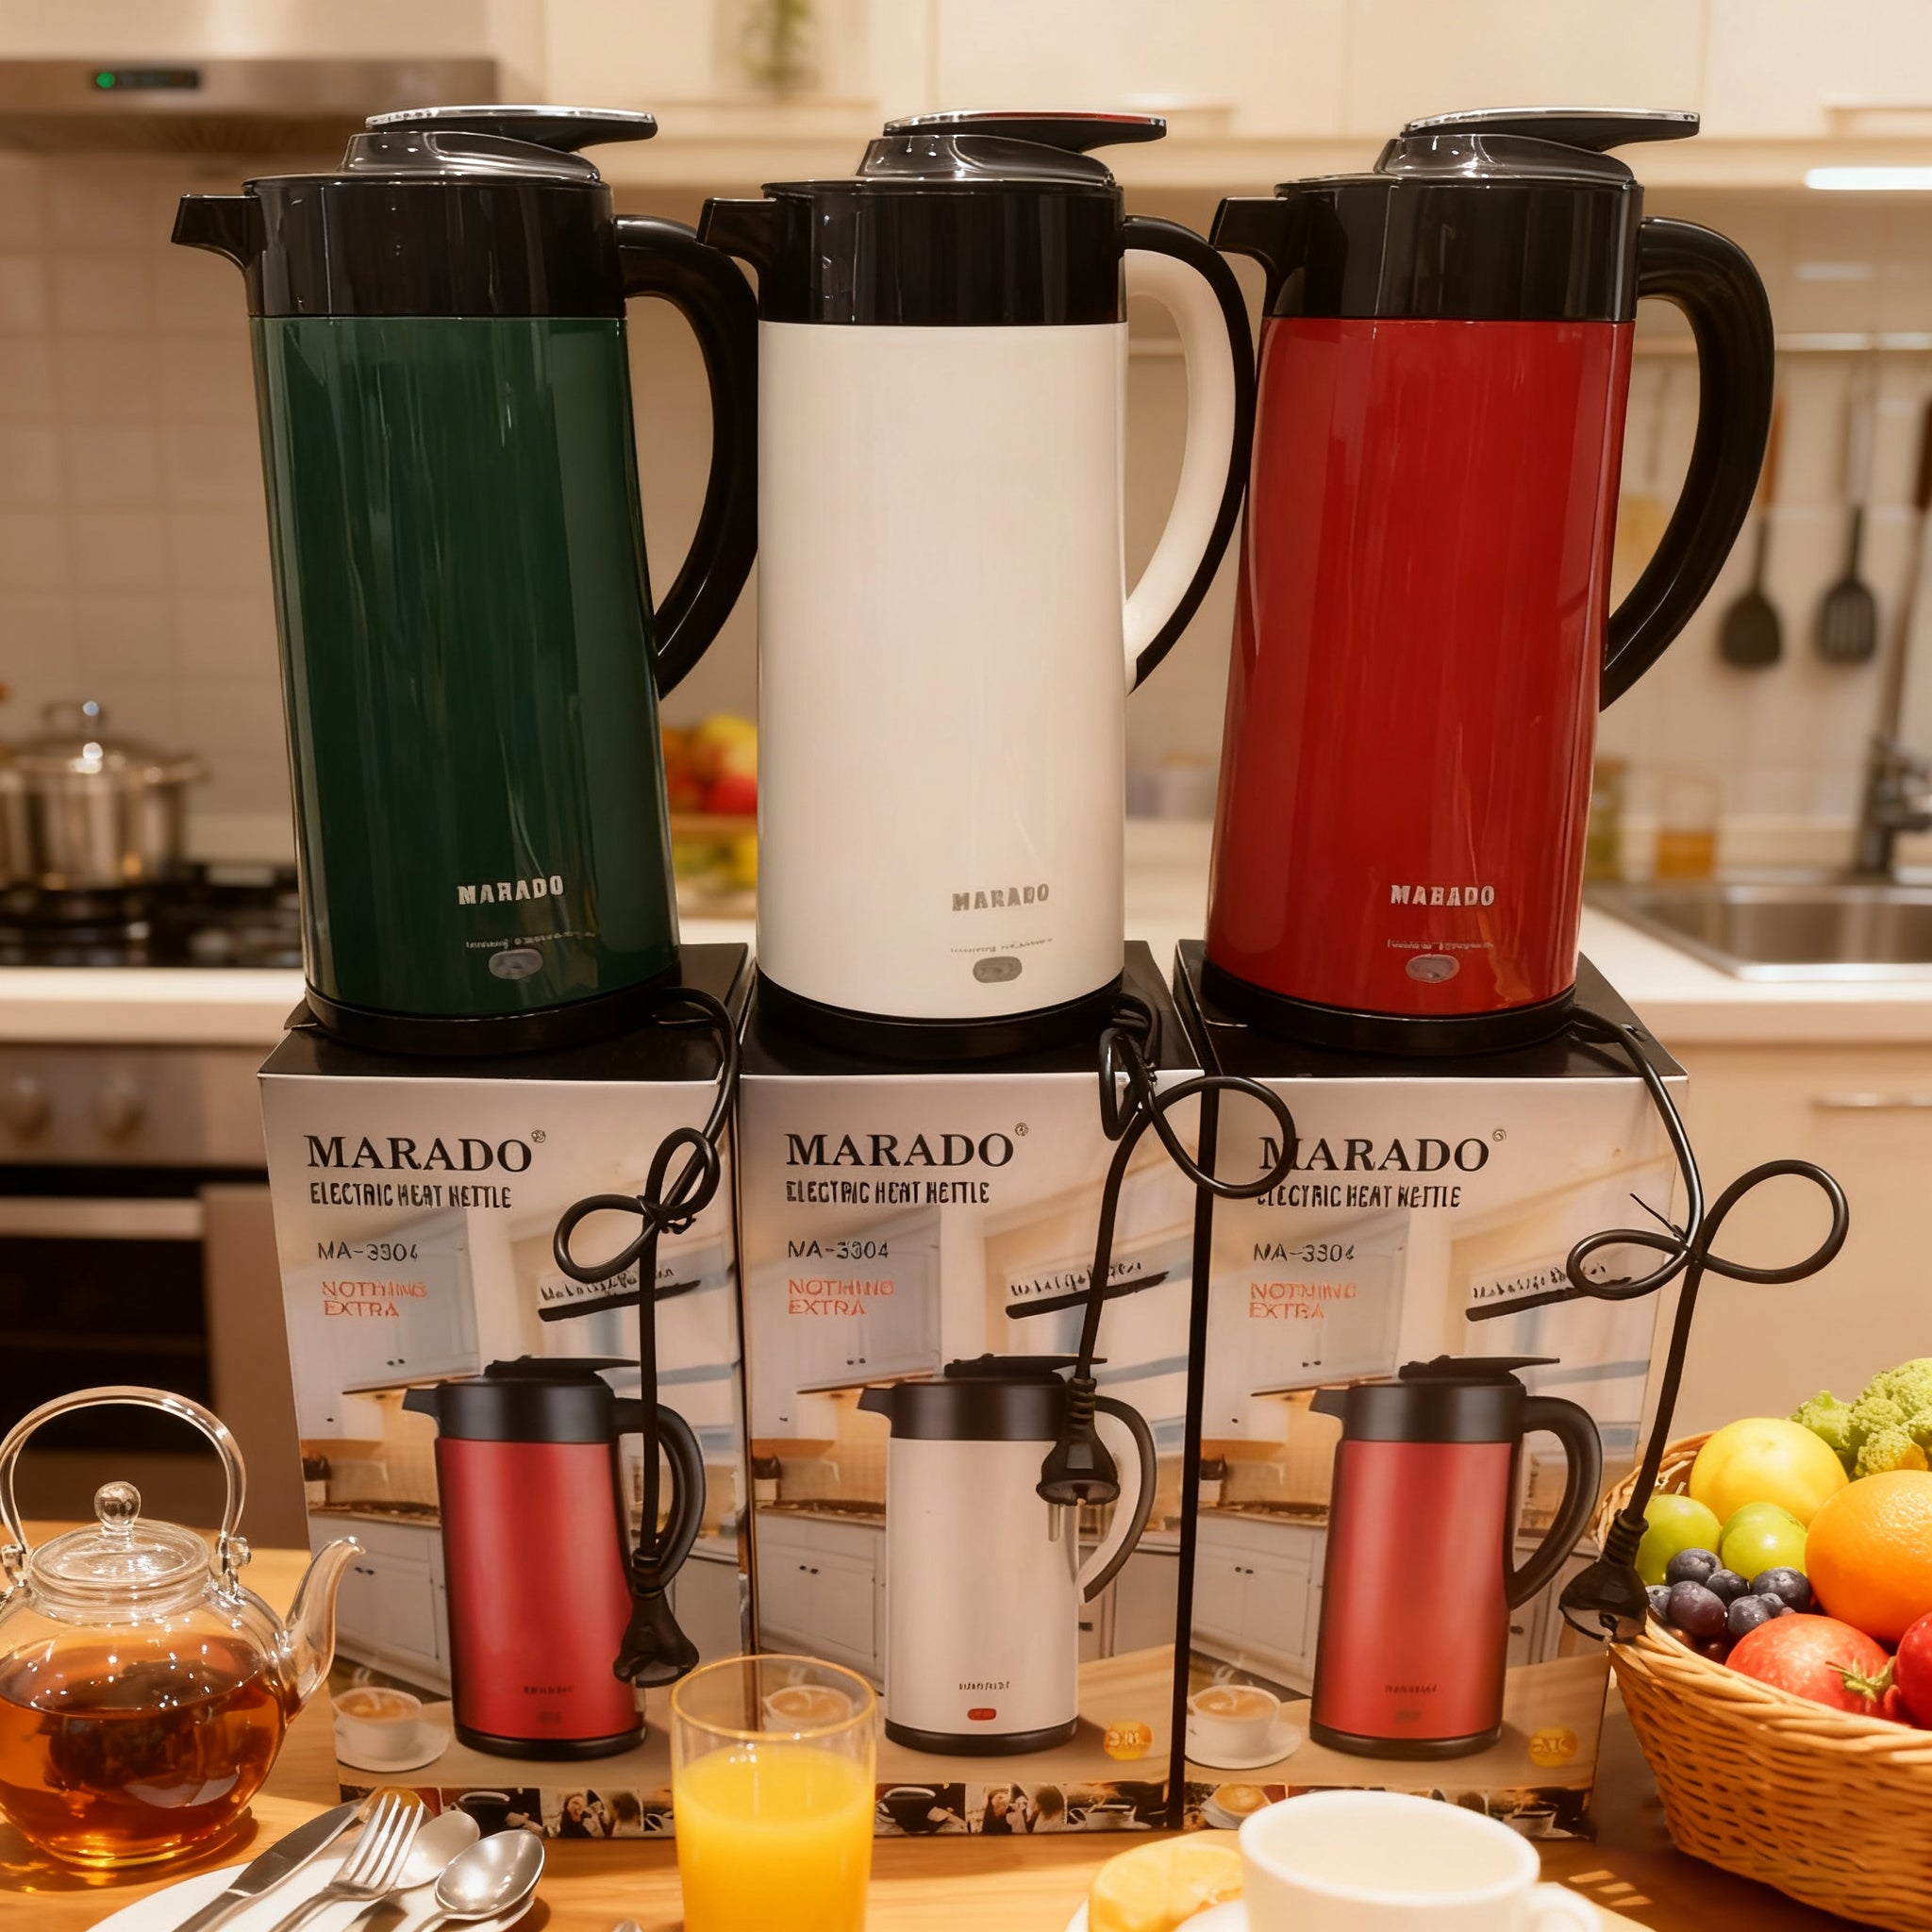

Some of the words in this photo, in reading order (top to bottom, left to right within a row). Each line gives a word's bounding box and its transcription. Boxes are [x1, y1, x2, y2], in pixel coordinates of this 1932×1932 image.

[952, 883, 1050, 911] MARADO
[304, 1135, 532, 1173] MARADO
[785, 1132, 1014, 1167] MARADO
[788, 1298, 866, 1315] EXTRA
